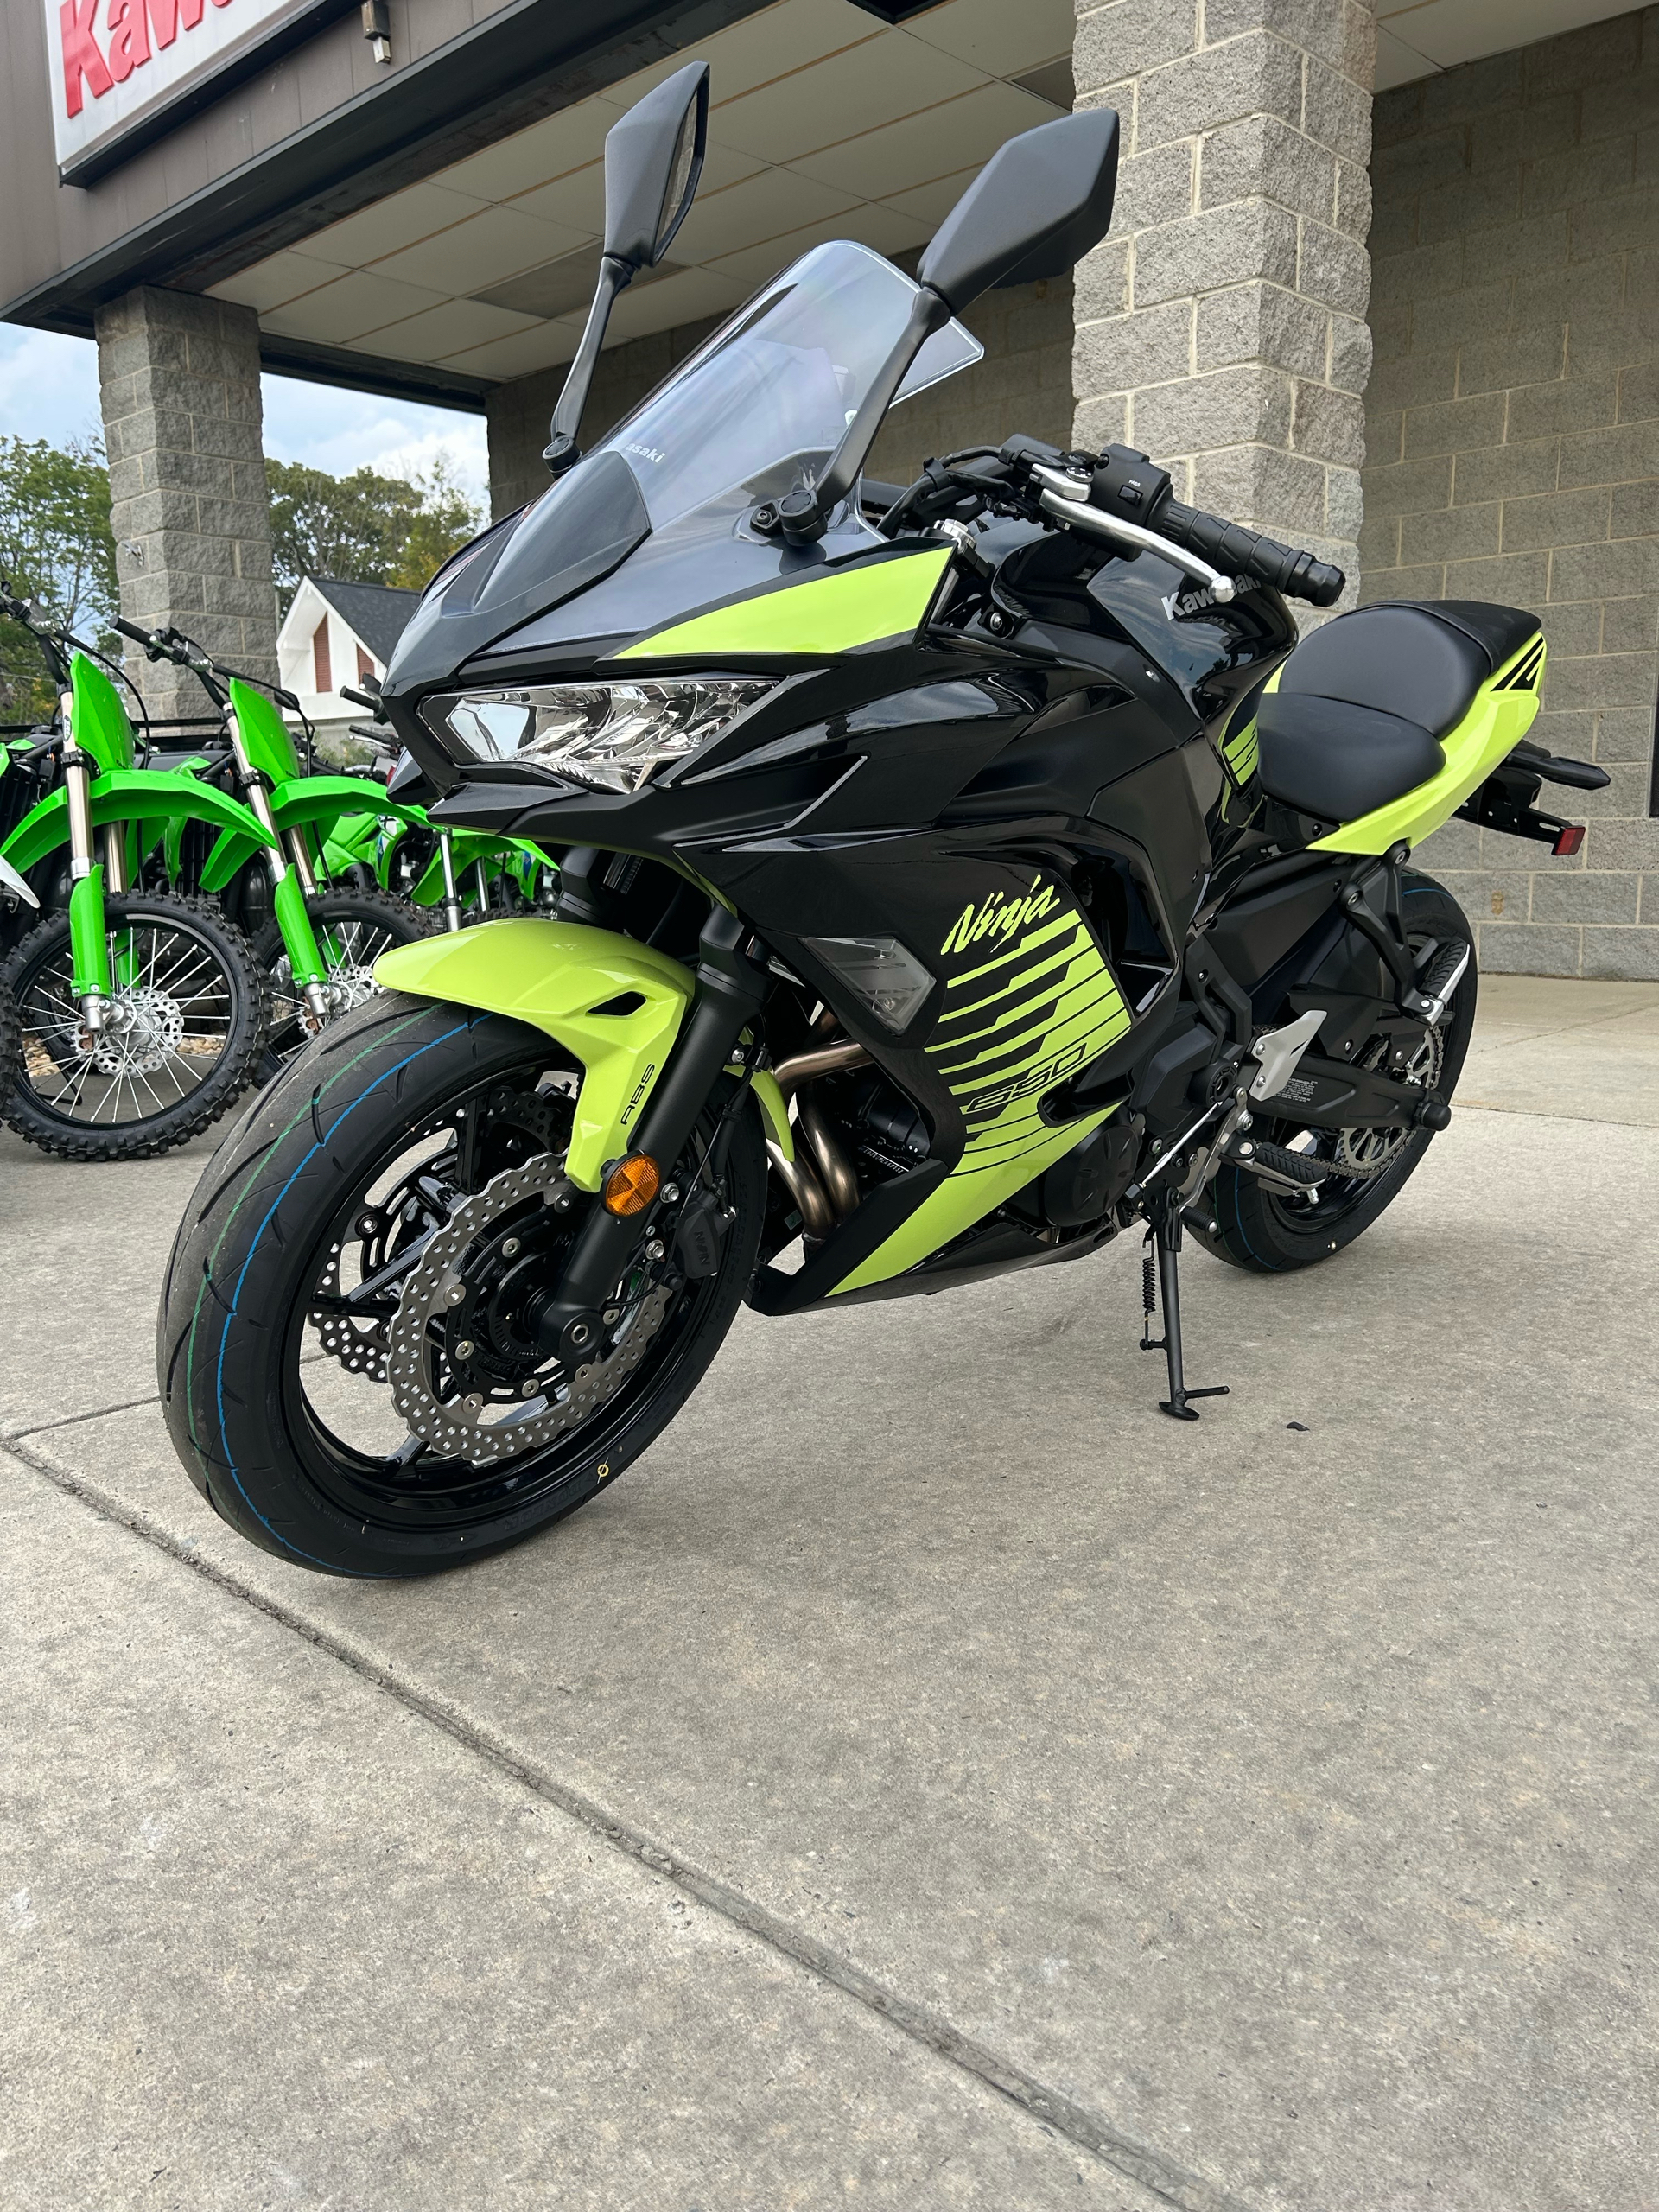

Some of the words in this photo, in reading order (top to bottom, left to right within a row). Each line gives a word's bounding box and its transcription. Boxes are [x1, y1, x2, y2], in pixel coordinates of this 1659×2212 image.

[60, 0, 233, 119] Kaw
[1128, 479, 1141, 487] PASS
[940, 874, 1061, 955] Ninja
[620, 1064, 655, 1125] ABS
[966, 1042, 1088, 1113] 650
